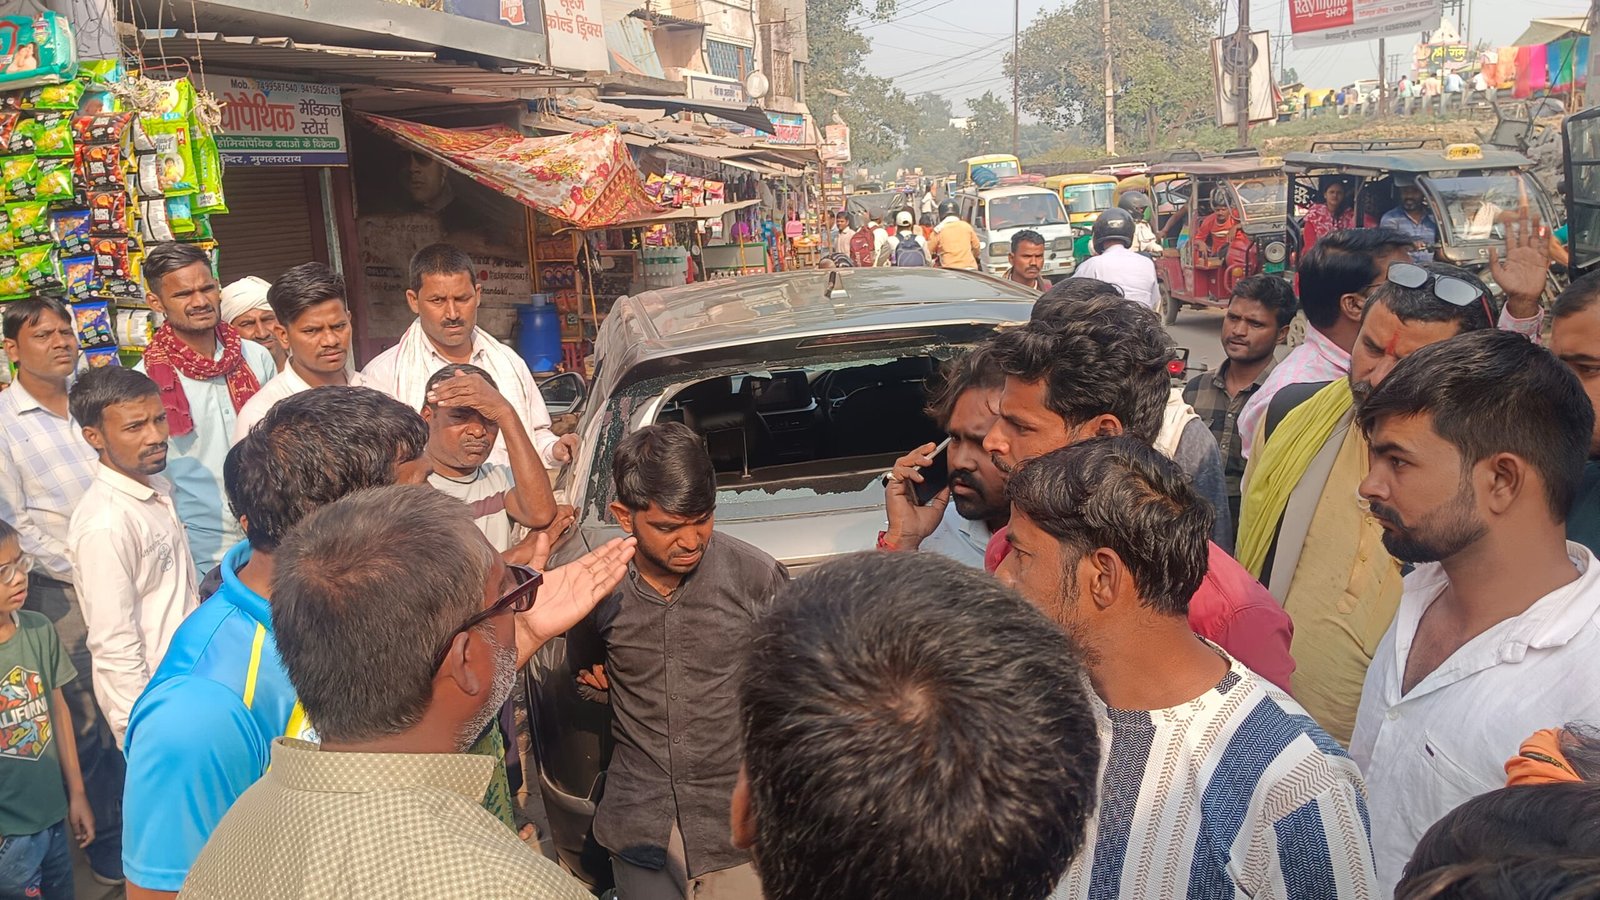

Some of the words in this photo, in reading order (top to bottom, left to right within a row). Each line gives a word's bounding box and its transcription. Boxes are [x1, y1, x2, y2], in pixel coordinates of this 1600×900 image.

[1325, 6, 1348, 18] SHOP
[546, 10, 574, 34] कोल्ड
[576, 16, 602, 41] ड्रिंक्स
[298, 99, 341, 117] मेडिकल
[301, 118, 329, 135] स्टोर्स
[302, 137, 311, 148] के
[250, 155, 301, 166] मुगलसराय
